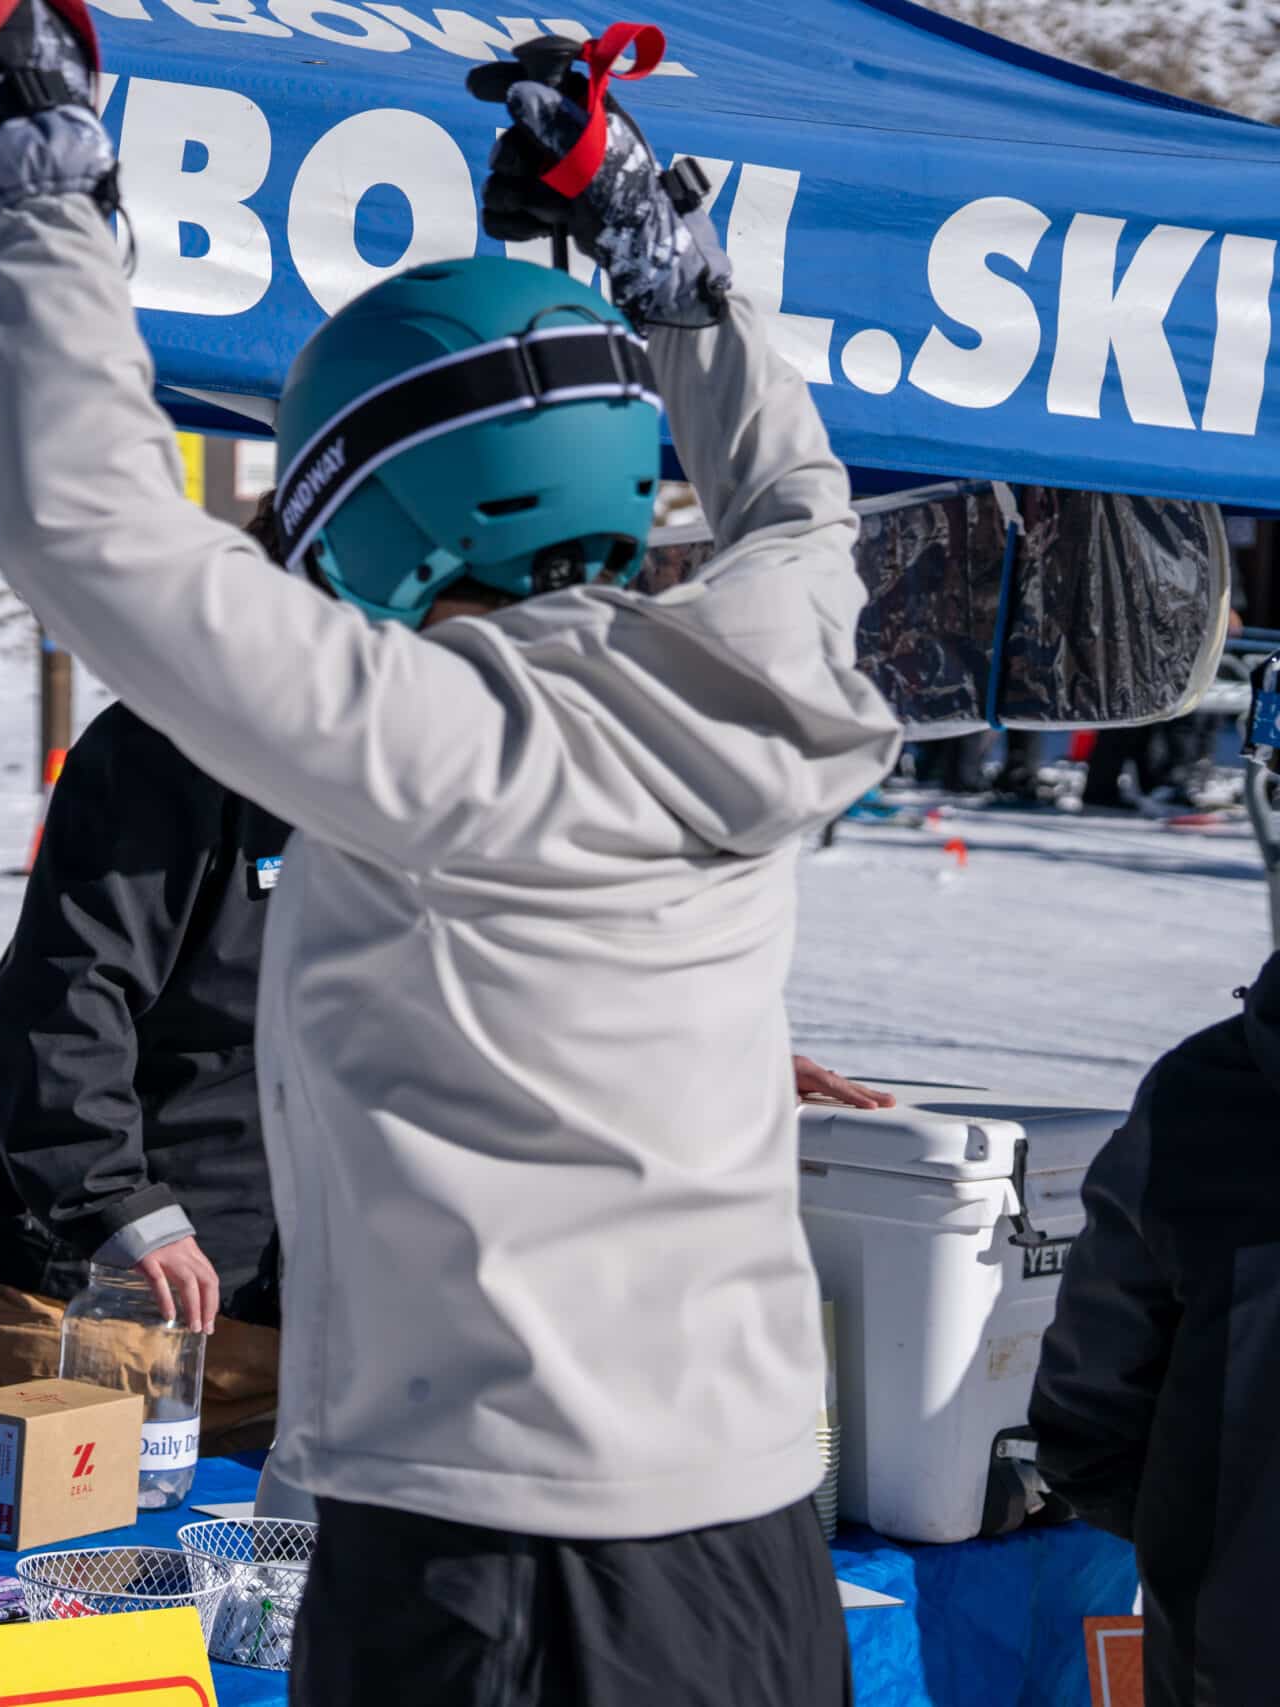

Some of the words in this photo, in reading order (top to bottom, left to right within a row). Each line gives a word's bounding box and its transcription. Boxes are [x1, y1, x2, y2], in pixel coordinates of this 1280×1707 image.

[282, 437, 345, 536] FINDWAY
[140, 1436, 182, 1460] Daily
[70, 1484, 94, 1496] ZEAL
